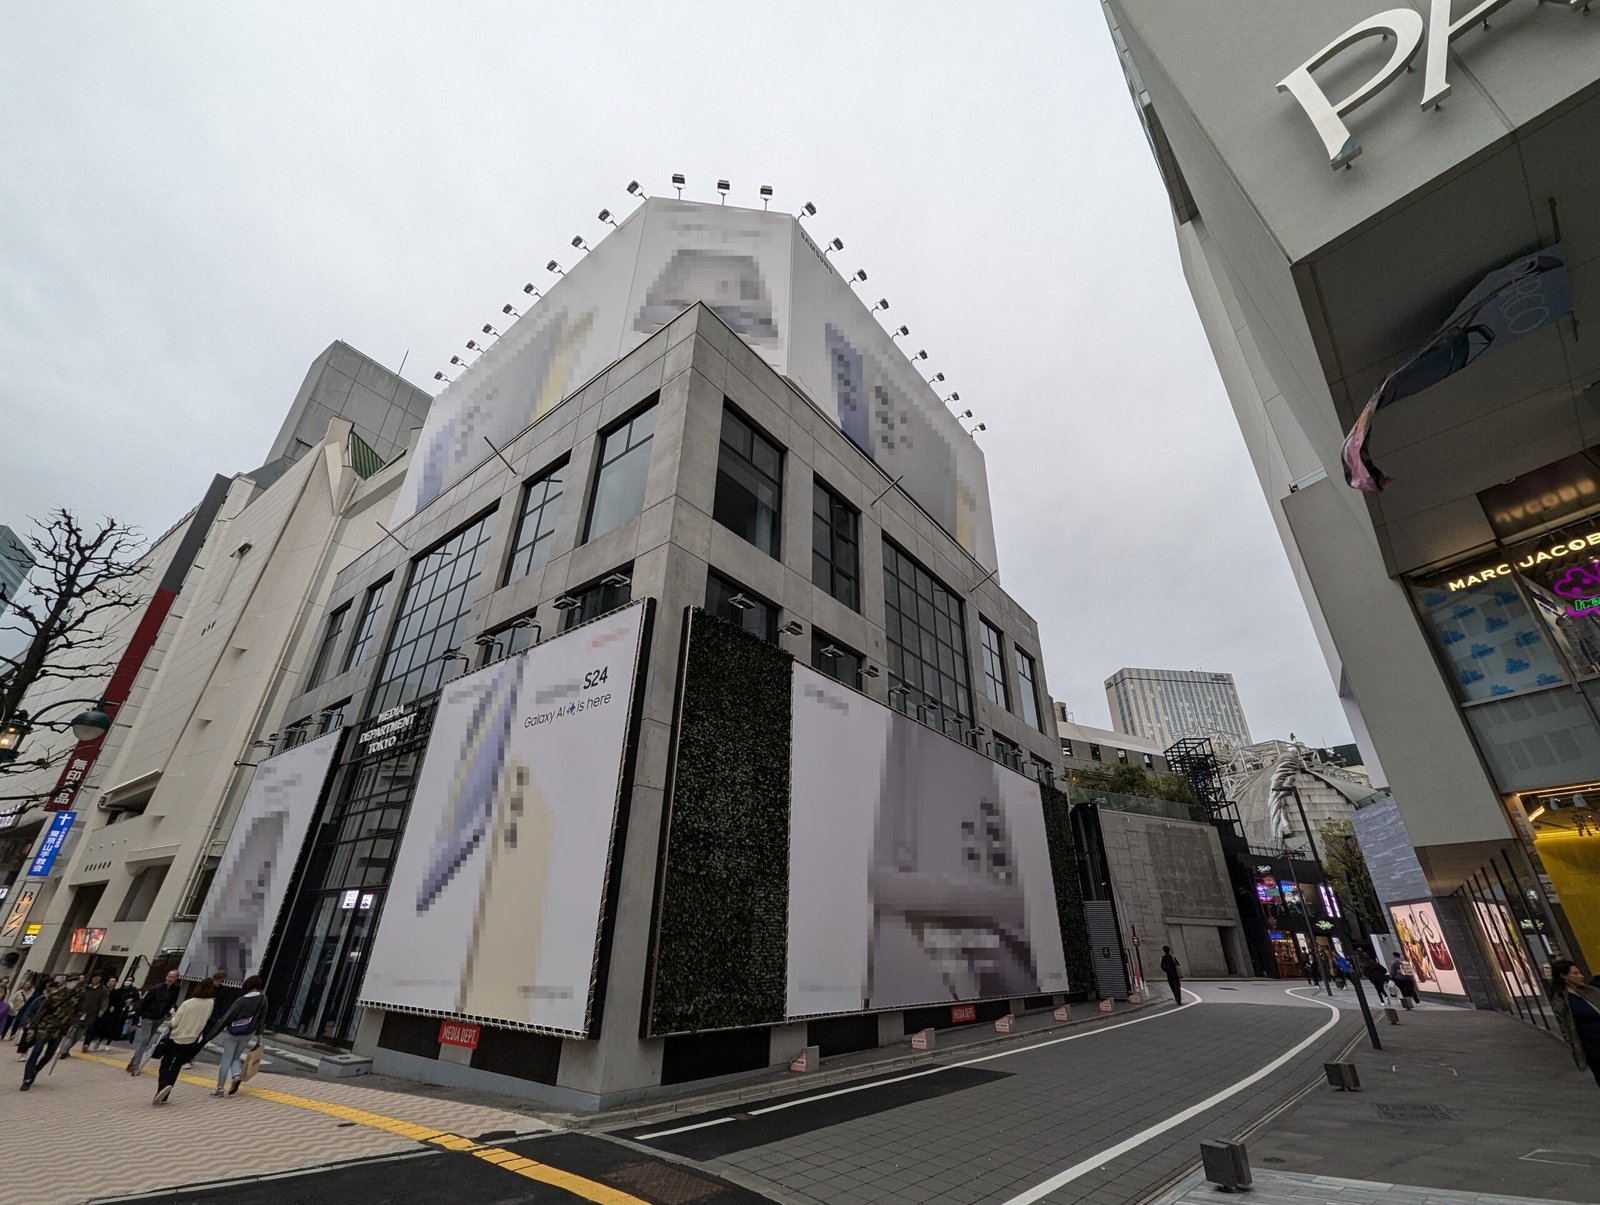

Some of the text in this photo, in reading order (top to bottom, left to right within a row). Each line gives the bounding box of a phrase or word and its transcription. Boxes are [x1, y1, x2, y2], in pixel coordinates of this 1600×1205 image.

[1448, 563, 1512, 592] MARC
[583, 666, 608, 690] S24
[377, 704, 404, 724] MEDIA
[524, 693, 612, 729] Galaxy AI is here
[359, 712, 418, 744] DEPARTMENT
[368, 736, 397, 755] TOKYO
[442, 1025, 477, 1045] MEDIA DEPT.
